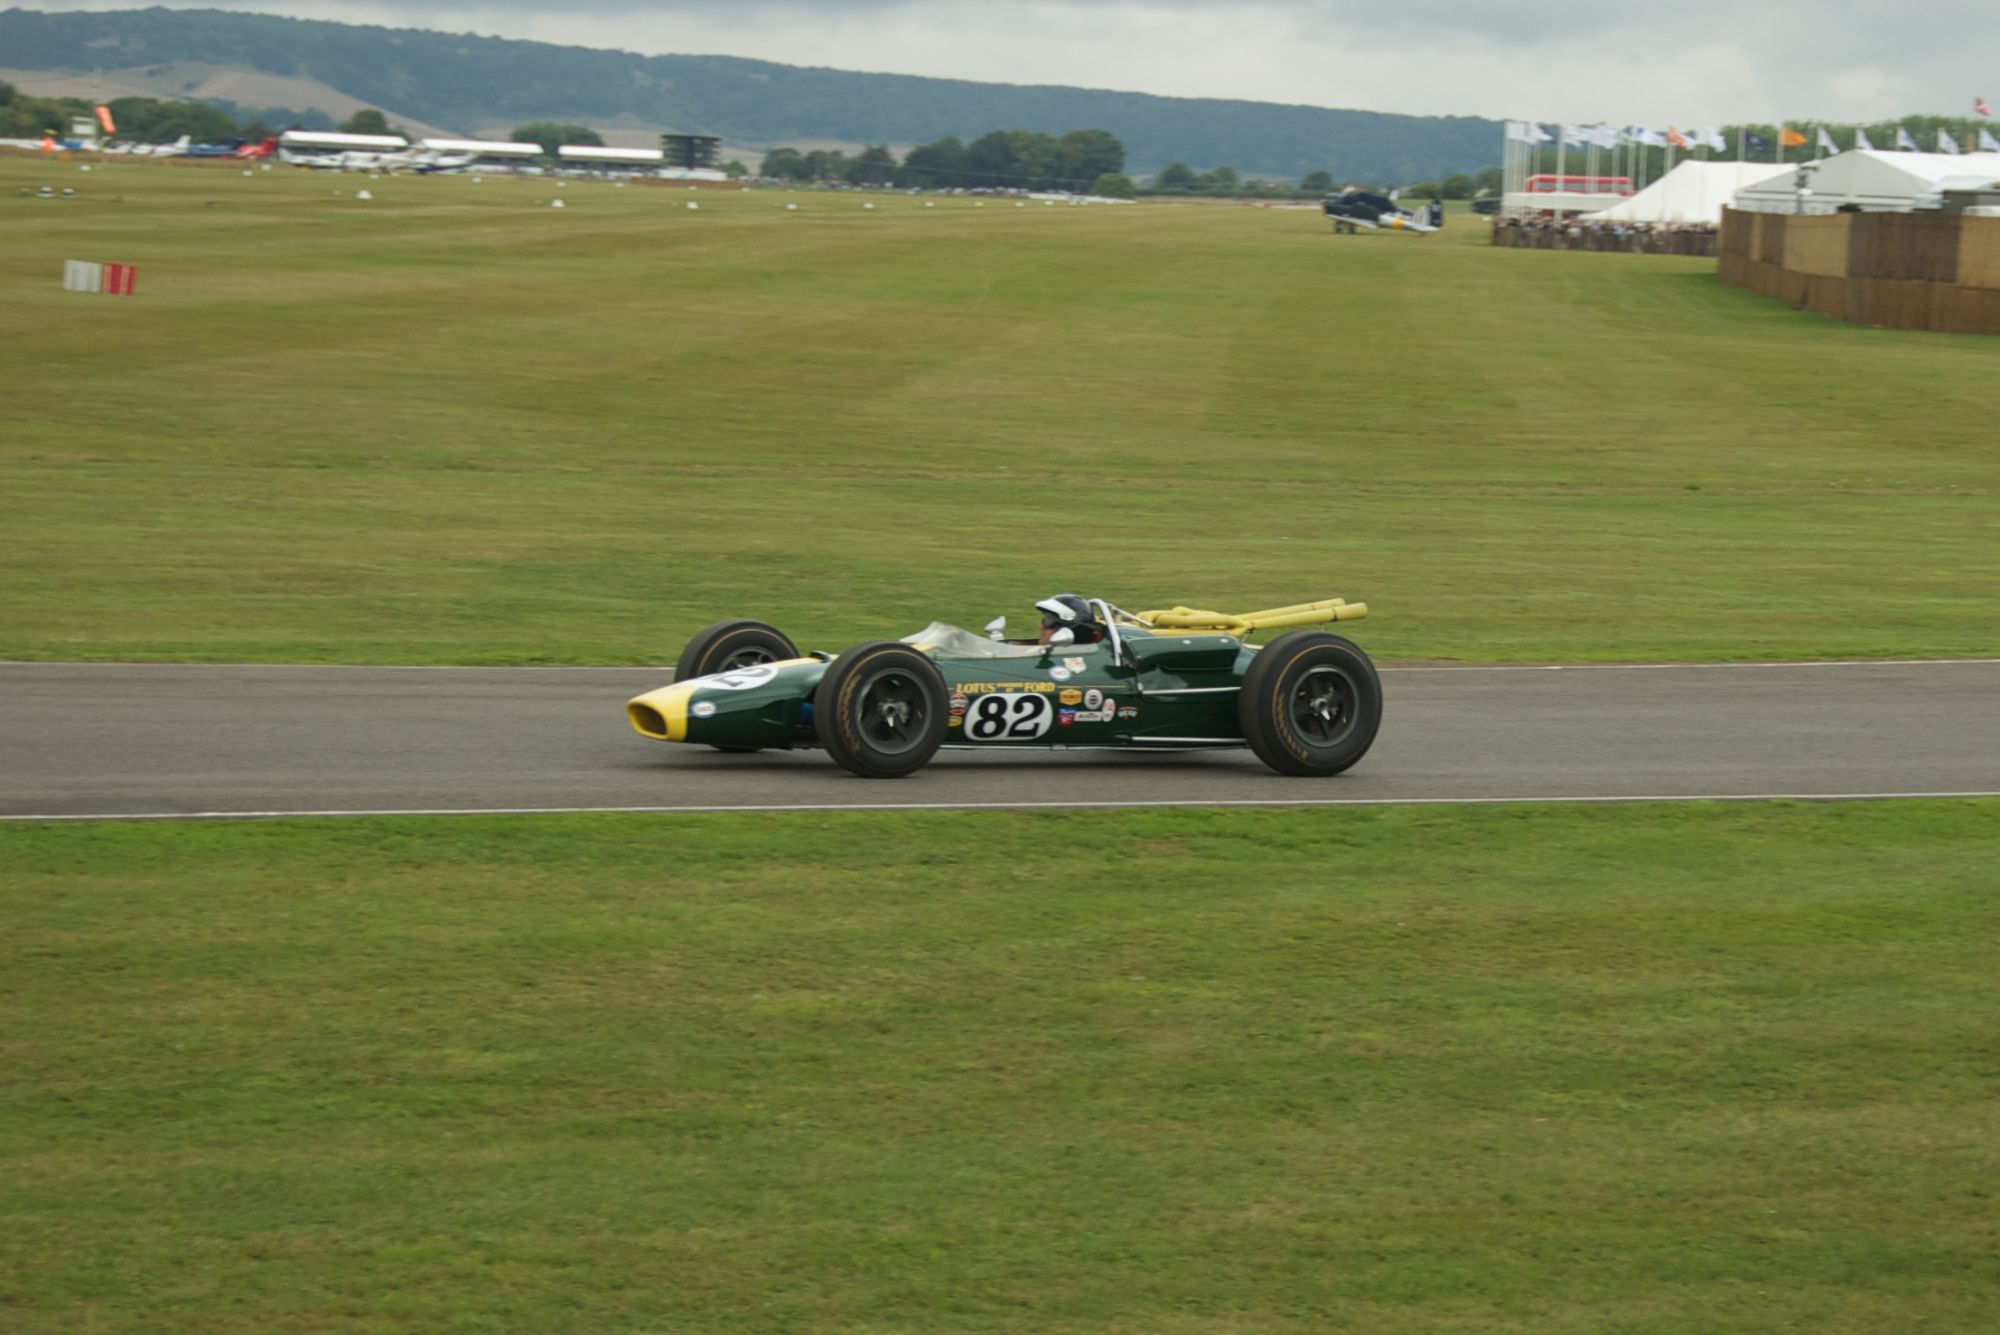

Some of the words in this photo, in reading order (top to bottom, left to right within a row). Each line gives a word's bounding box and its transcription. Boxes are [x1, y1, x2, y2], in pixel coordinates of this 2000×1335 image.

[956, 682, 997, 693] LOTUS
[1023, 682, 1056, 692] FORD
[972, 695, 1044, 737] 82
